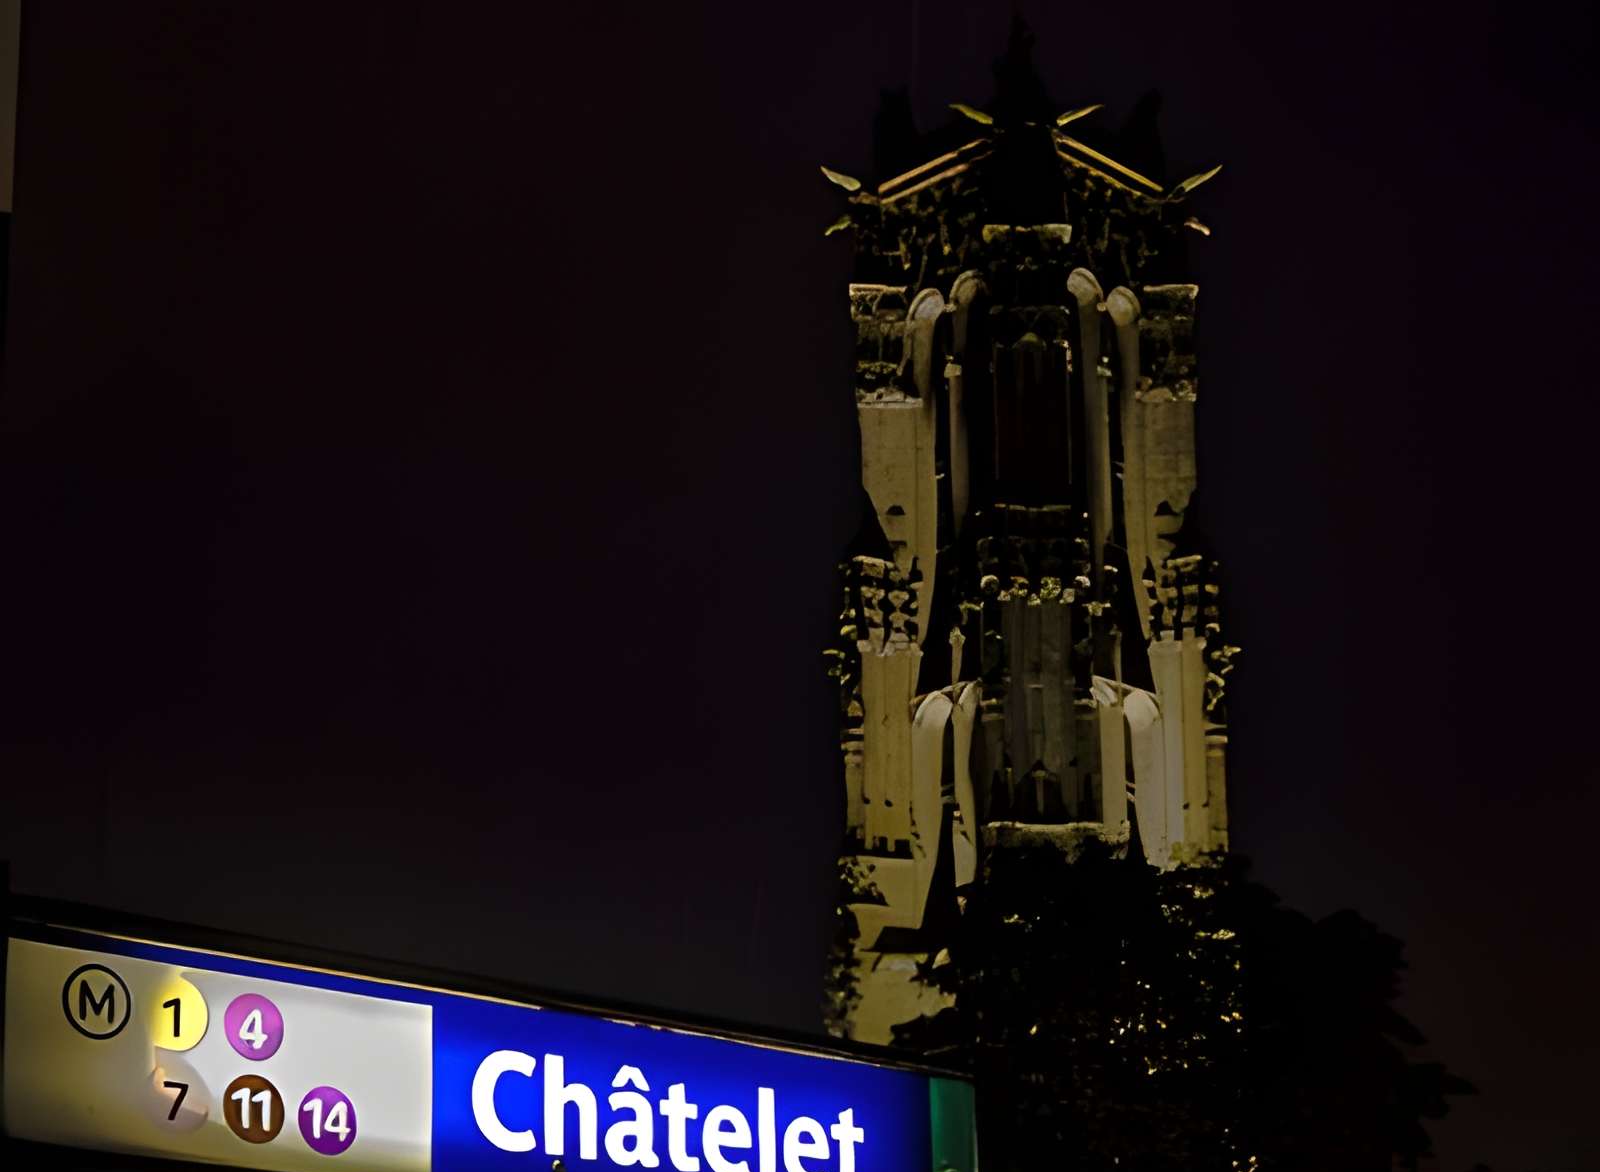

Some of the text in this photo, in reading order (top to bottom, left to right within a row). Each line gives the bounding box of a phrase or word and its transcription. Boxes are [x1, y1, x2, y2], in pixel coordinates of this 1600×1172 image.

[79, 979, 268, 1050] M 1 4
[163, 1081, 351, 1142] 7 11 14
